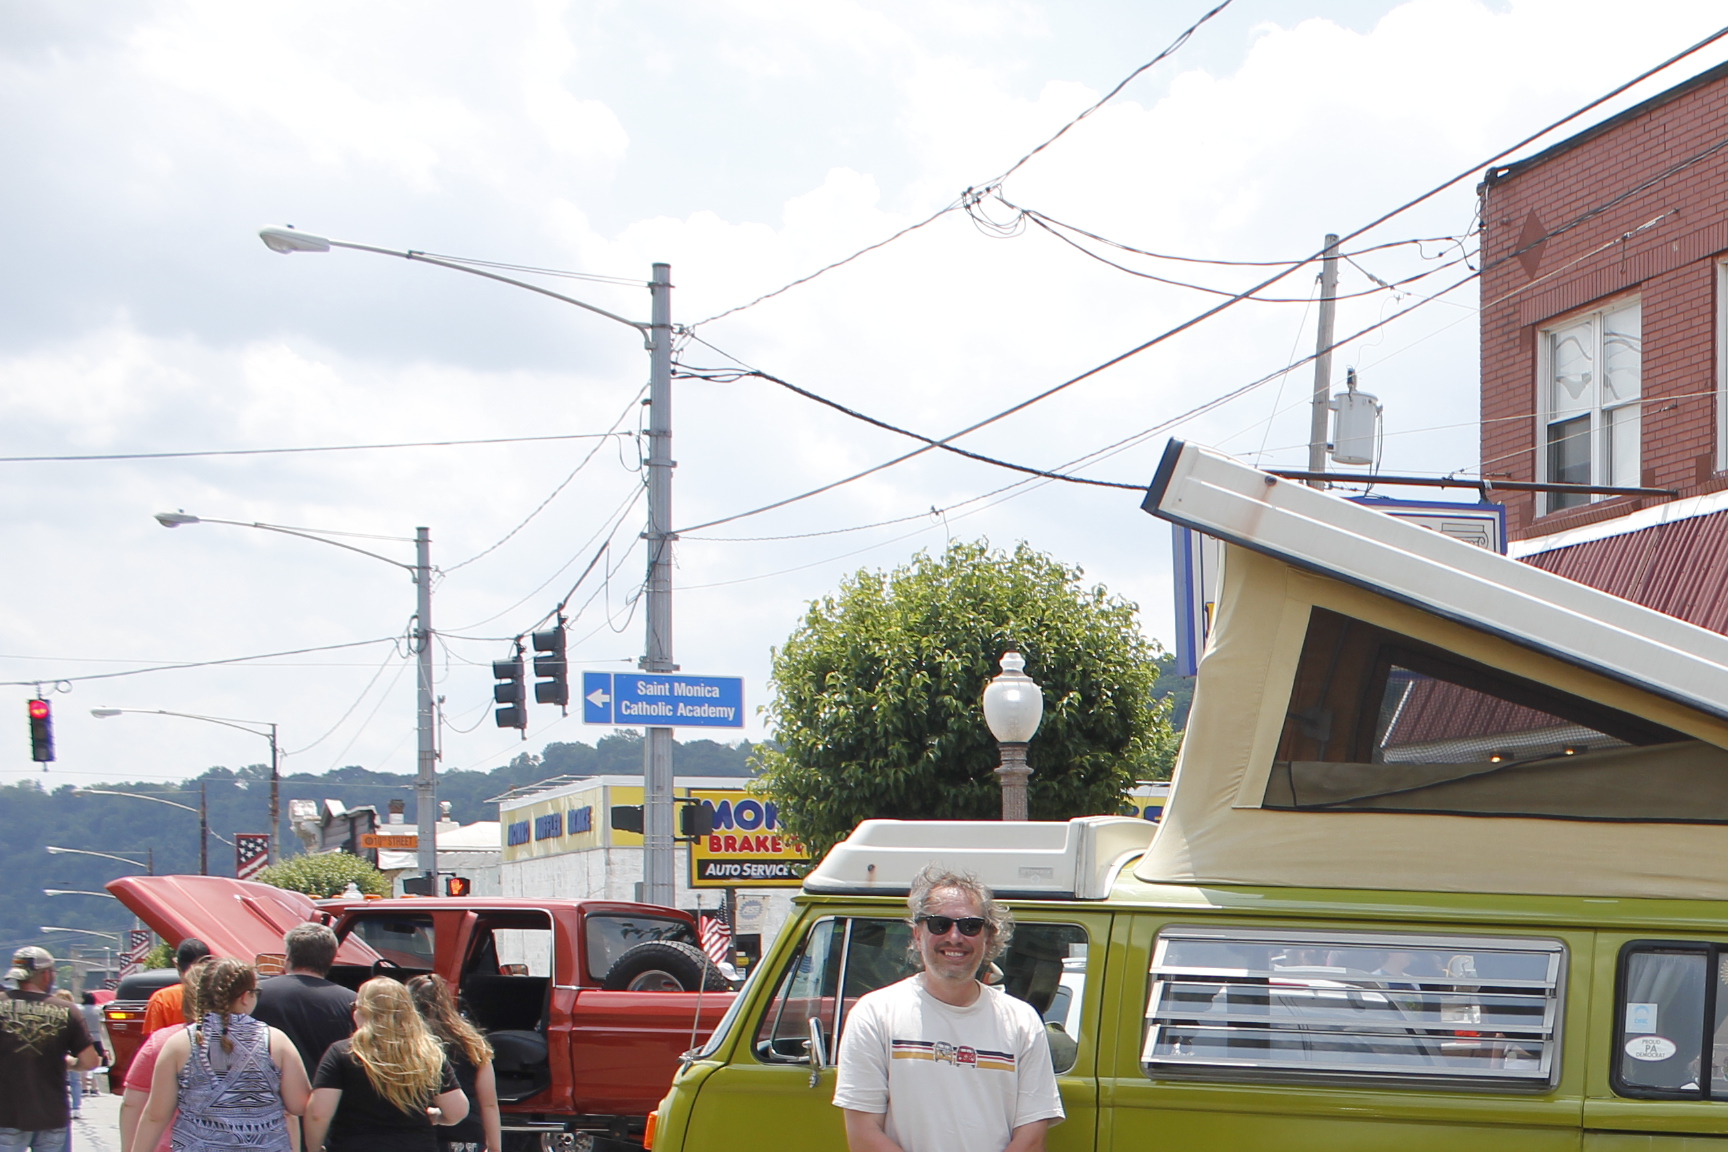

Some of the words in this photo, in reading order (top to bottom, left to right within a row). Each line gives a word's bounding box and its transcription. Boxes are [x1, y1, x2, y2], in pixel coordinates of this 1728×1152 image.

[637, 680, 670, 696] Saint
[674, 682, 720, 698] Monica
[621, 700, 673, 716] Catholic
[676, 703, 736, 721] Academy
[701, 799, 788, 831] MON
[388, 837, 412, 846] STREET
[708, 834, 783, 853] BRAKE
[705, 863, 741, 876] AUTO
[742, 863, 789, 876] SERVICE
[1645, 1044, 1658, 1053] PA
